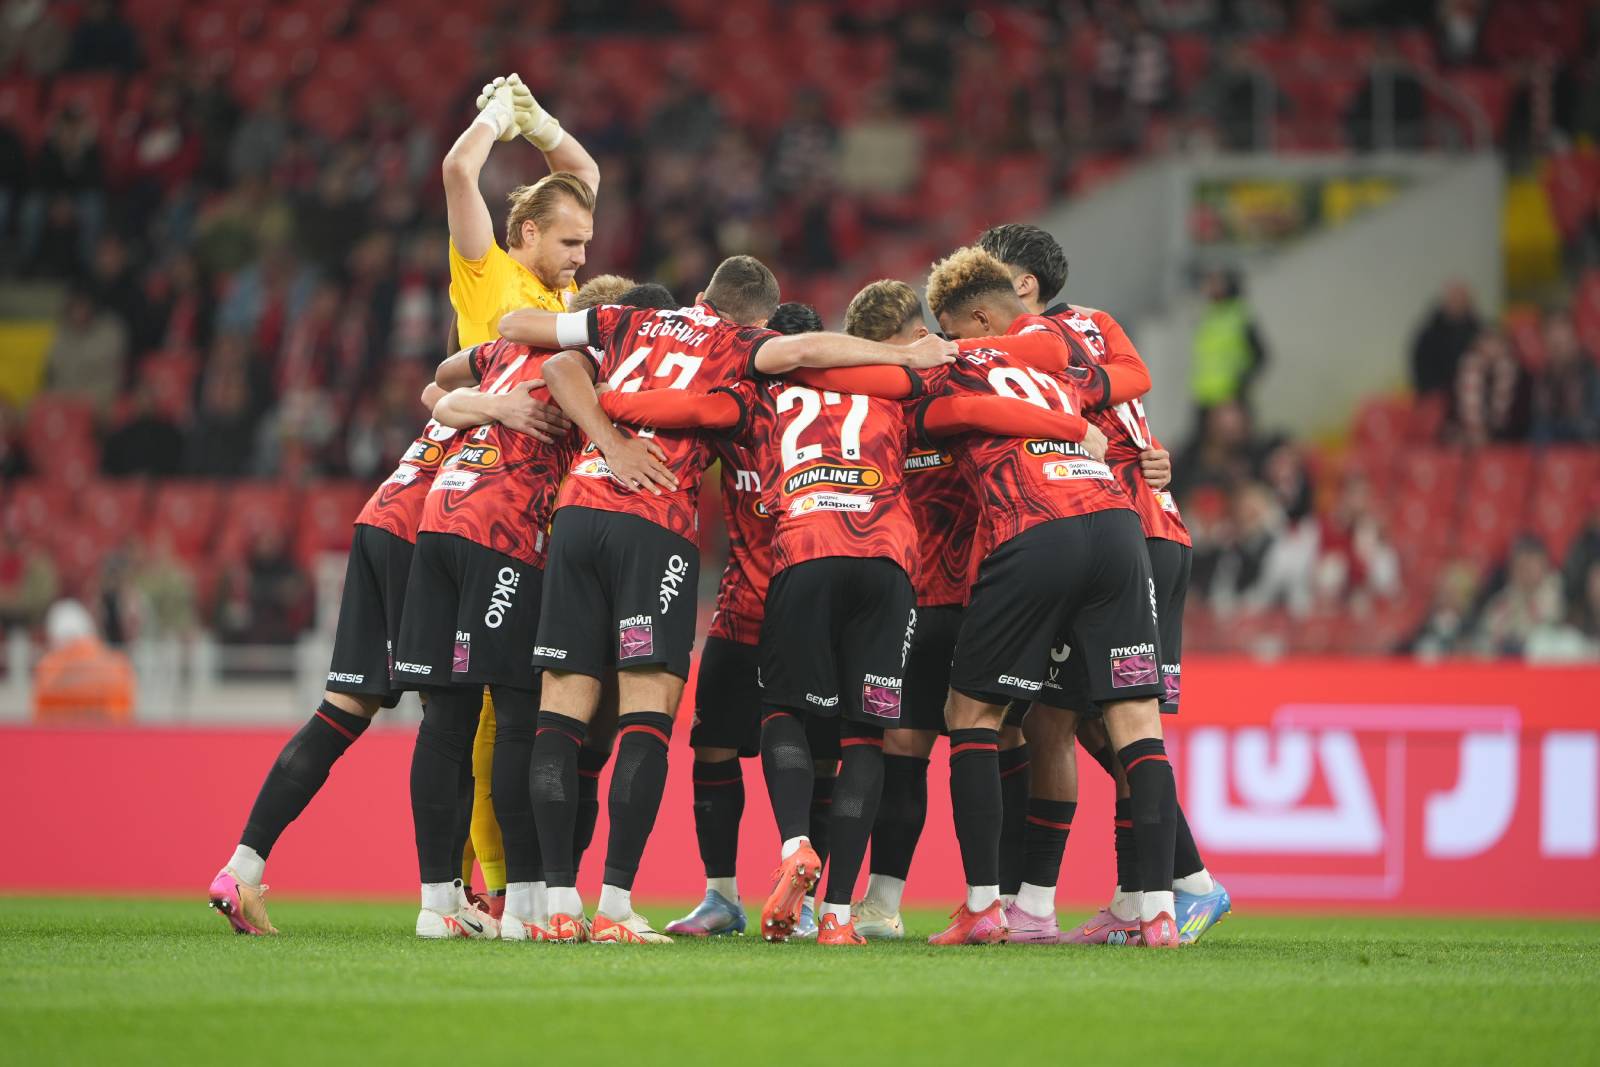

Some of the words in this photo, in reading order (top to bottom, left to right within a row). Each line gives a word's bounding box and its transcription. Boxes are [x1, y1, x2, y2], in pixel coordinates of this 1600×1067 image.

[776, 386, 870, 473] 27
[1031, 441, 1092, 458] WINLIN
[789, 469, 860, 492] WINLINE
[817, 500, 861, 509] Маркет
[619, 614, 652, 629] ЛУКОЙЛ
[1110, 643, 1155, 657] ЛУКОЙЛ
[395, 661, 432, 675] NESIS
[864, 673, 903, 688] ЛУКОЙЛ
